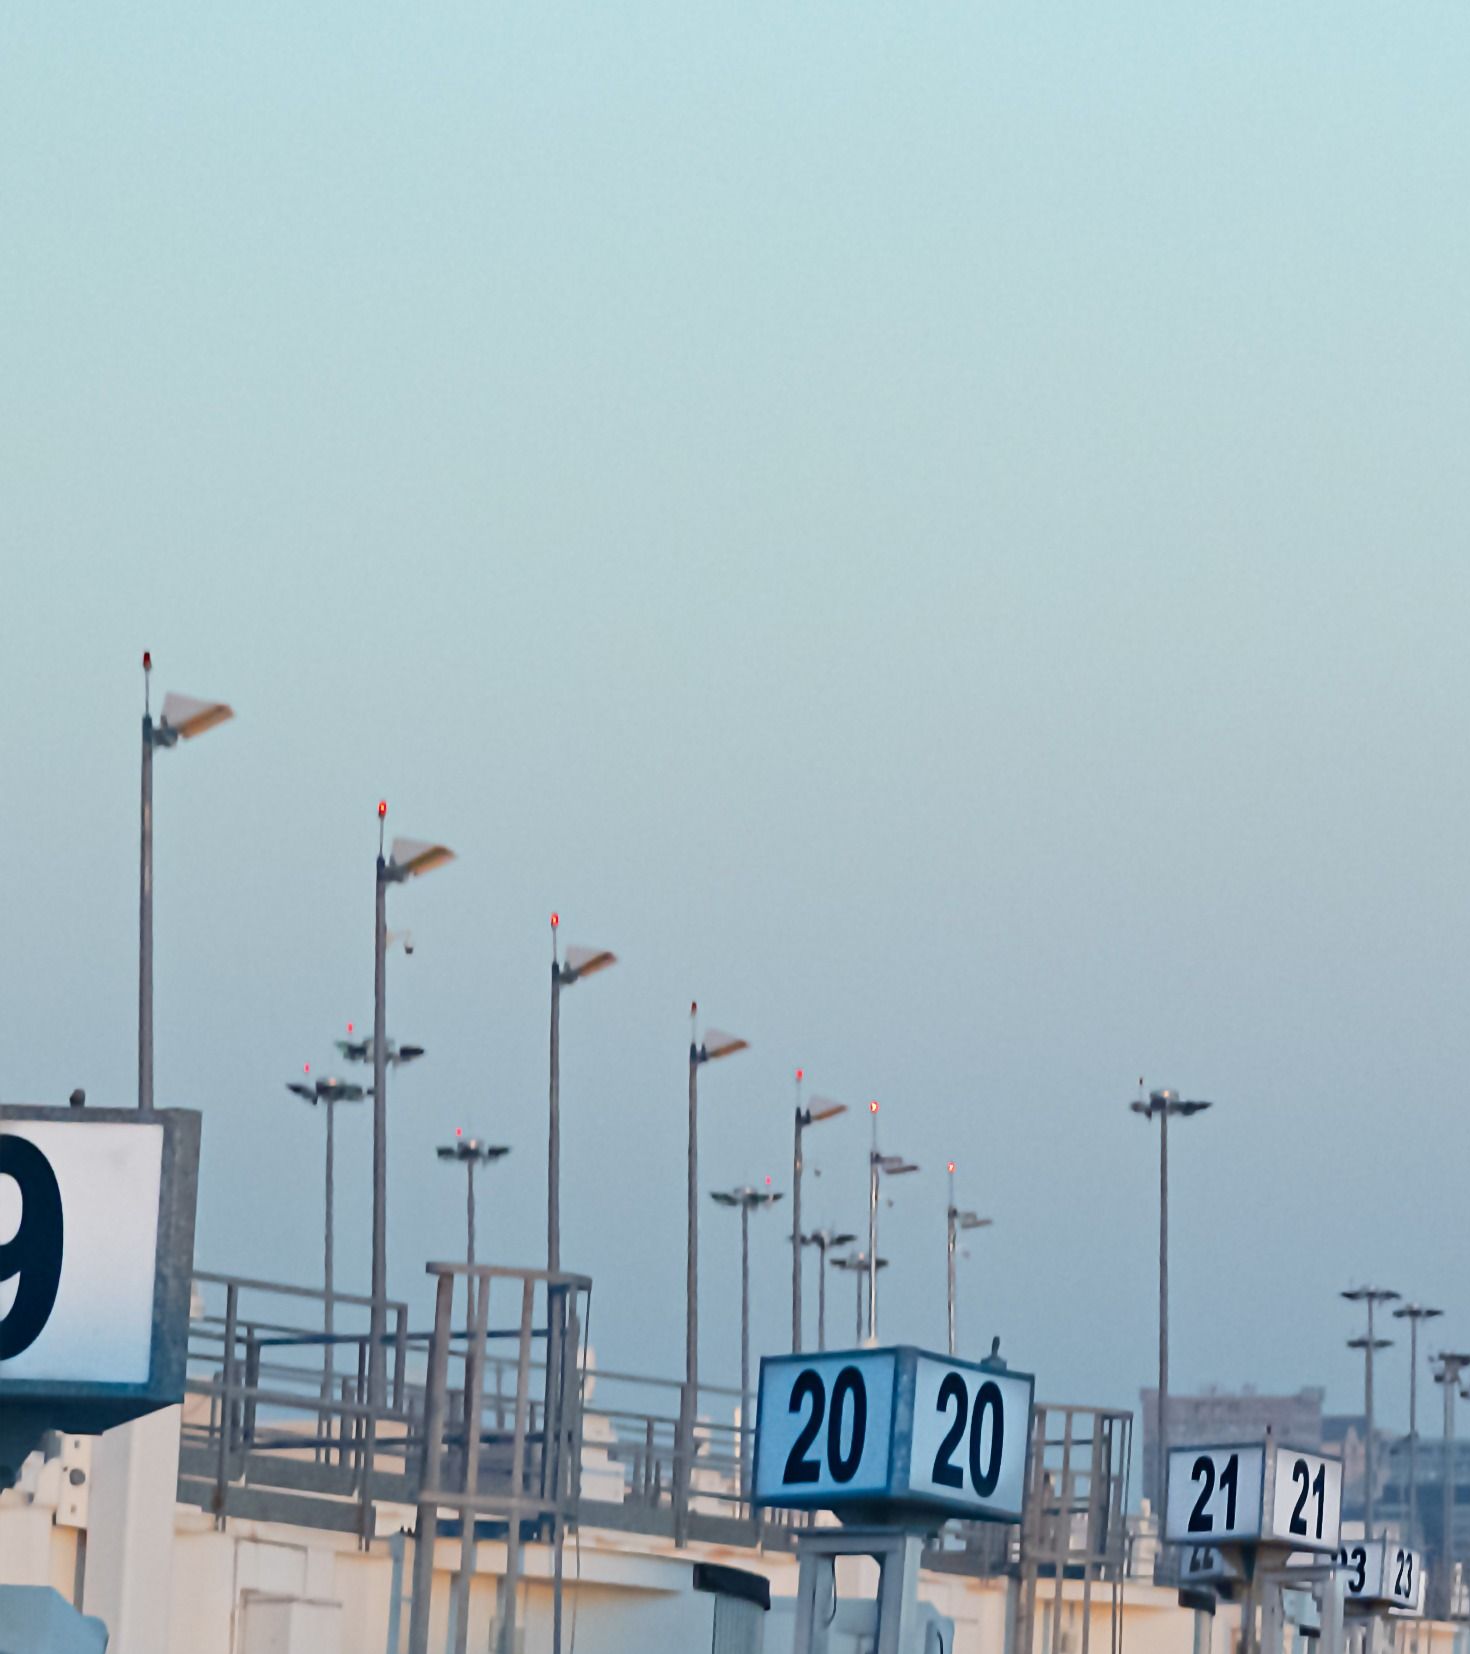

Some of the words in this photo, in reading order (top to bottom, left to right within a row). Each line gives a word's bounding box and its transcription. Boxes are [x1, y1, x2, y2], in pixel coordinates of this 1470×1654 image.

[782, 1365, 867, 1487] 20
[931, 1372, 1005, 1498] 20
[1188, 1454, 1239, 1533] 21
[1289, 1458, 1326, 1540] 21
[1394, 1549, 1413, 1599] 23
